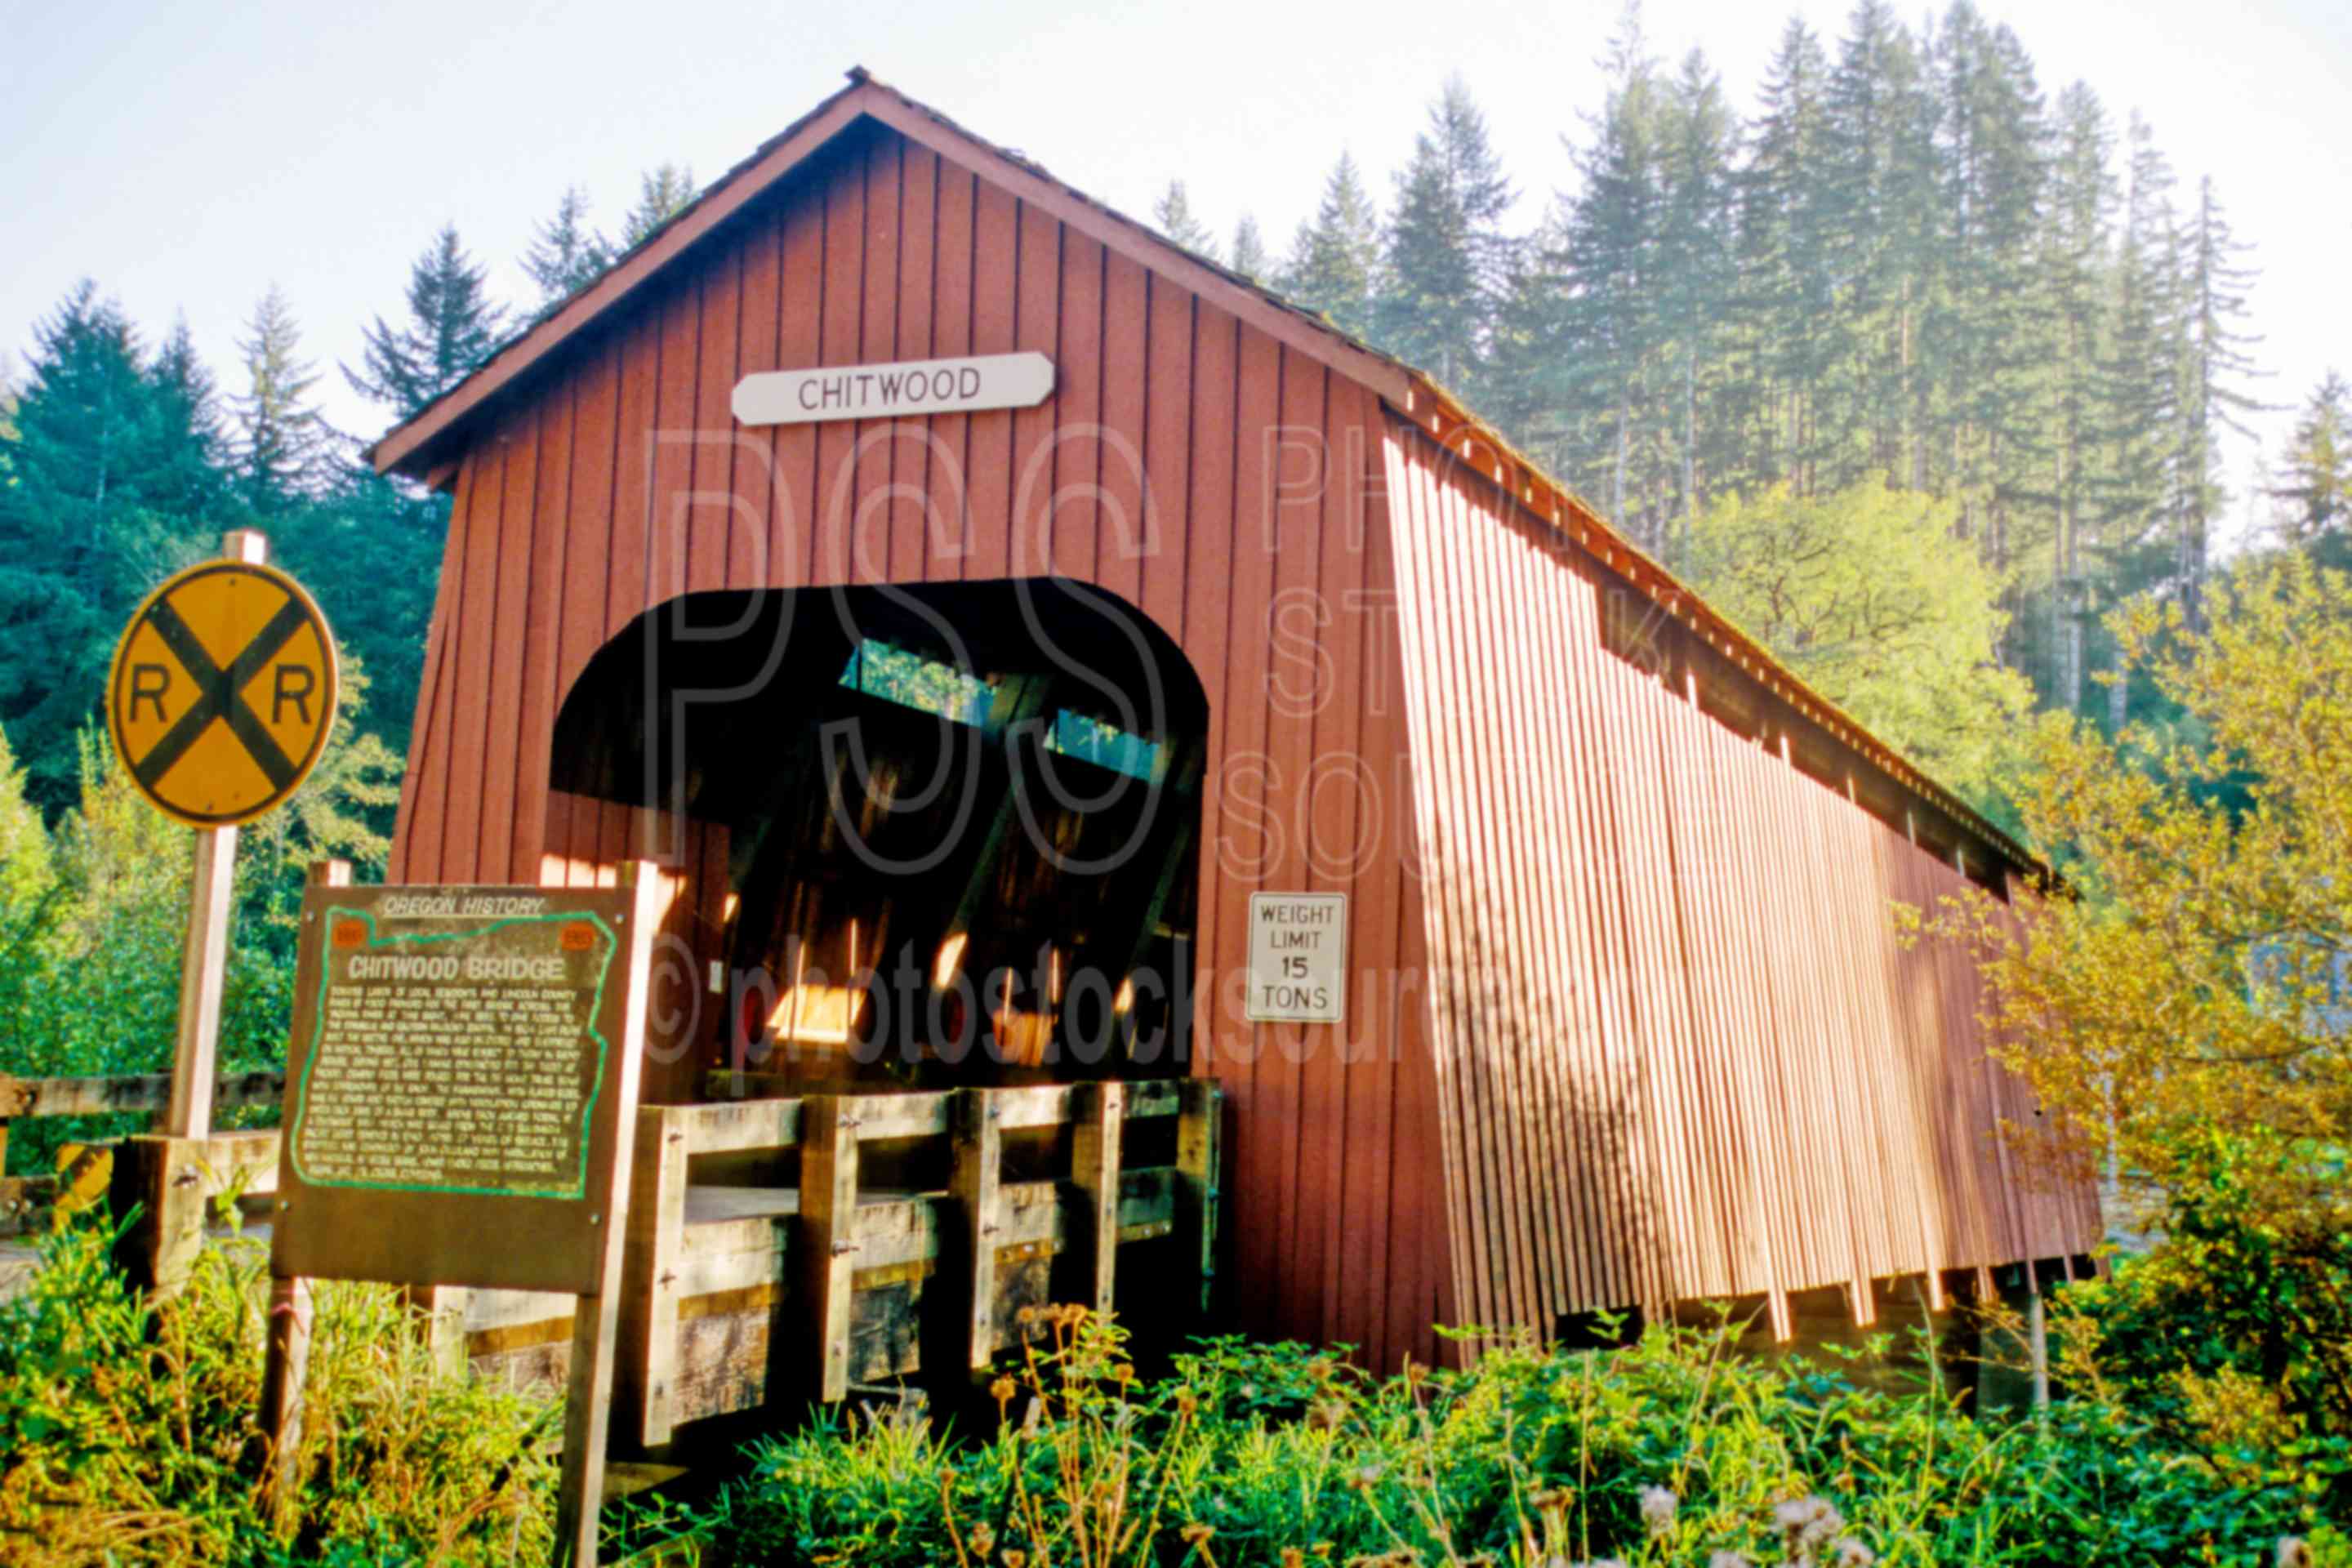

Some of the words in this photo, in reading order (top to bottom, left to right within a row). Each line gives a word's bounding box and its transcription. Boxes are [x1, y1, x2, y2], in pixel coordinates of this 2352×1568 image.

[798, 367, 981, 411] CHITWOOD
[129, 663, 171, 724] R
[272, 664, 315, 724] R
[381, 897, 456, 915] OREGON
[463, 897, 546, 915] HISTORY
[1261, 904, 1334, 924] WEIGHT
[1271, 930, 1321, 949] LIMIT
[348, 955, 458, 980] CHITWOOD
[466, 956, 566, 980] BRIDGE
[1282, 956, 1308, 978] 15
[1262, 985, 1328, 1010] TONS
